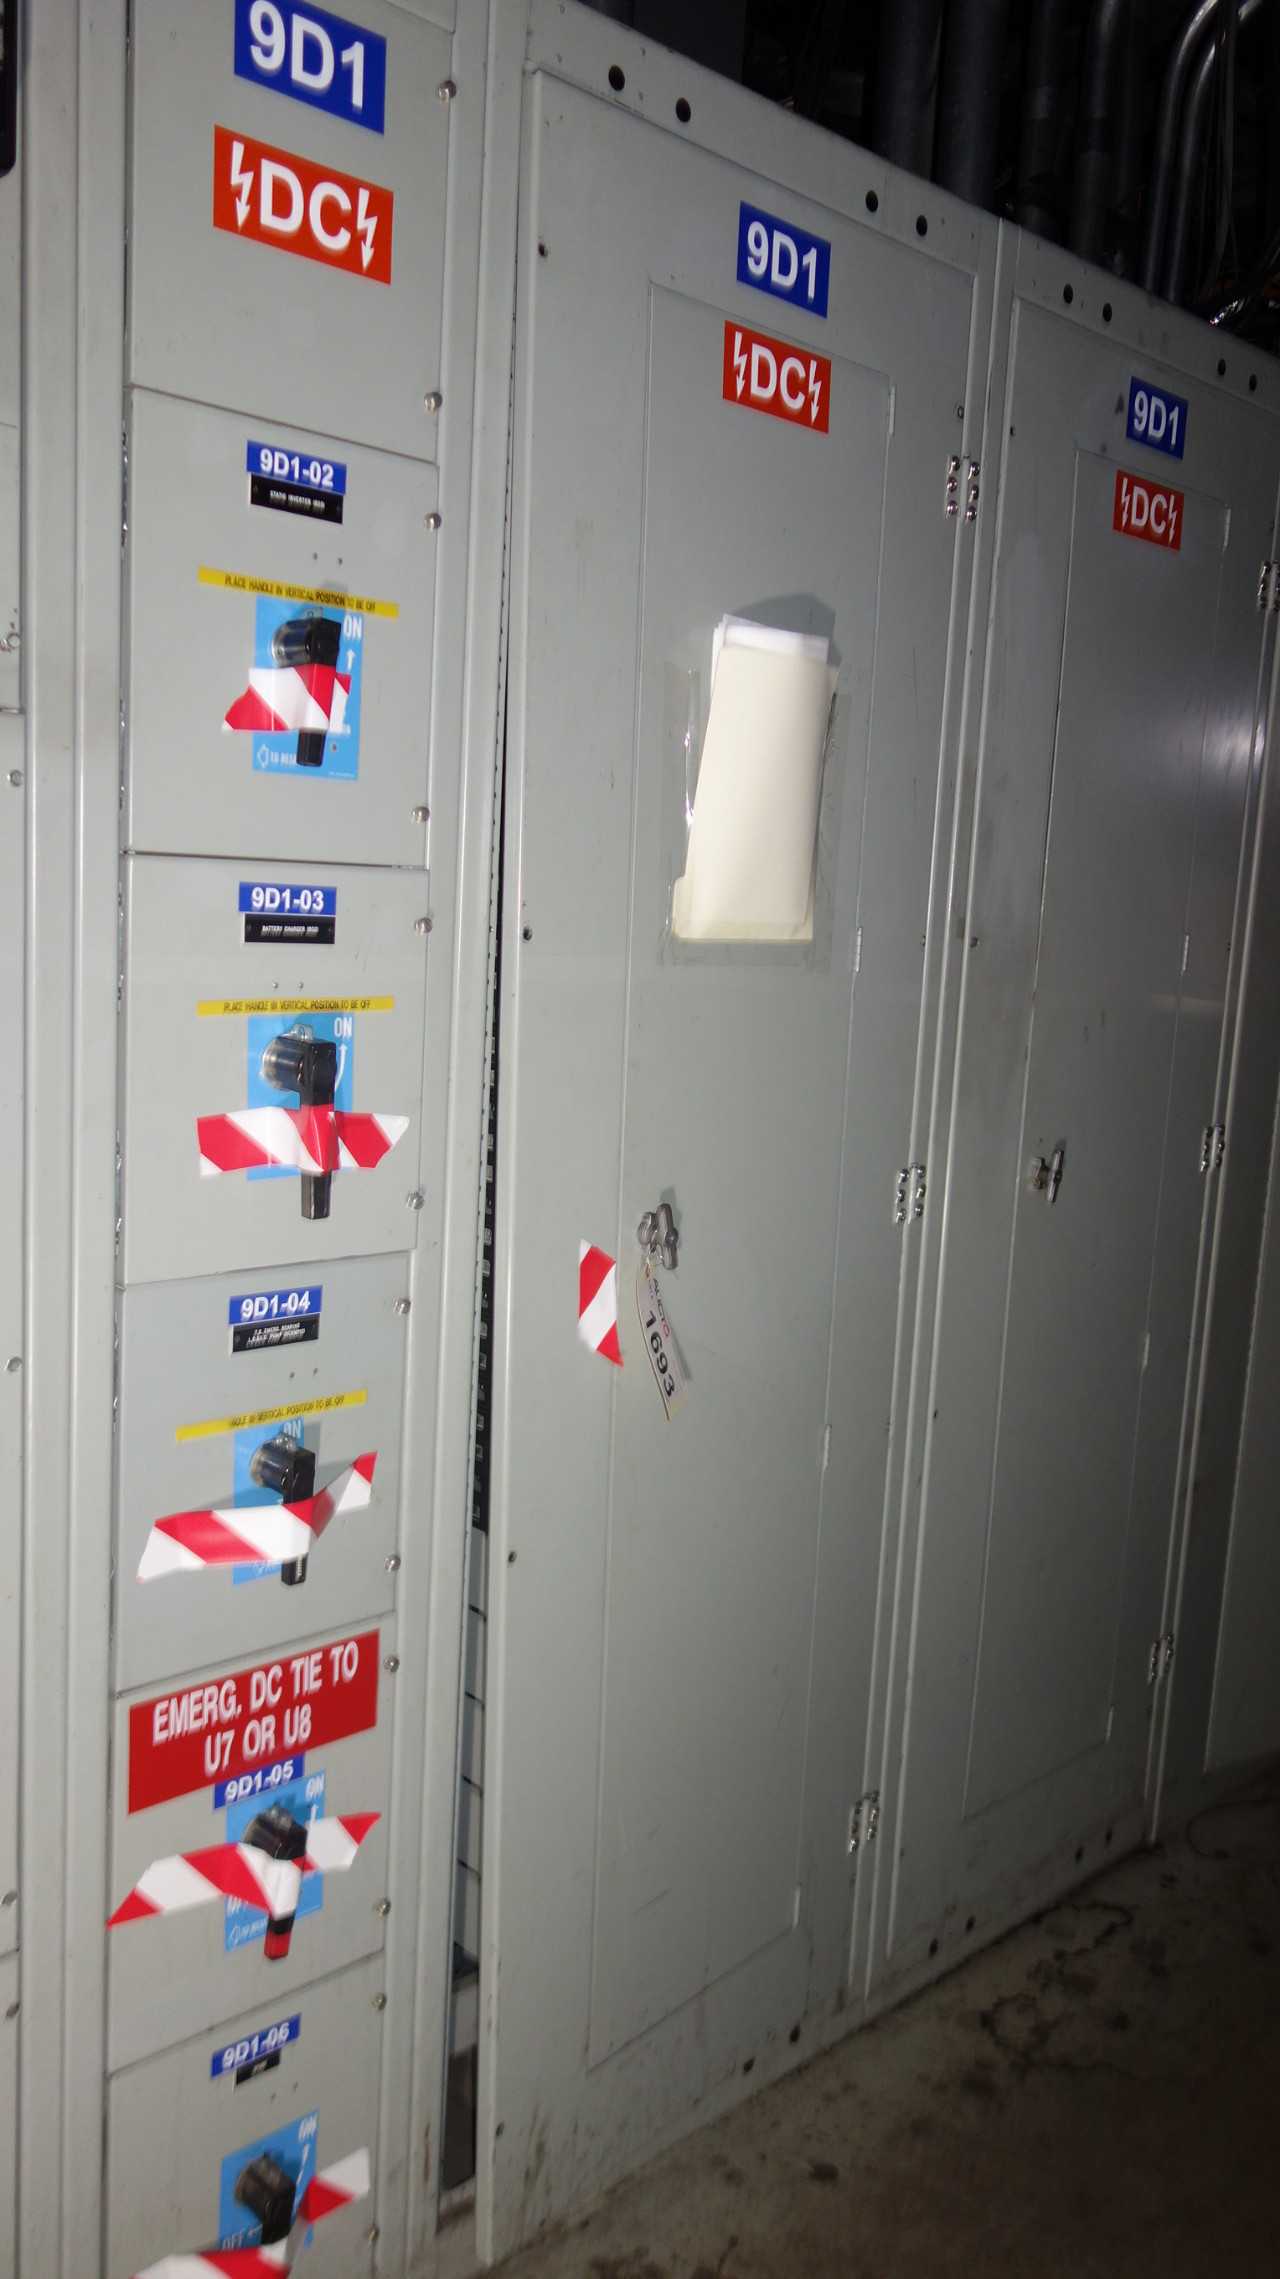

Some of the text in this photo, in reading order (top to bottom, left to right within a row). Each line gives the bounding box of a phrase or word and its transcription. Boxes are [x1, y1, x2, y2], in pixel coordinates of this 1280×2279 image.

[249, 0, 365, 110] 9D1
[260, 158, 352, 252] DC
[747, 221, 818, 302] 9D1
[750, 343, 807, 411] DC
[1134, 390, 1180, 447] 9D1
[260, 448, 334, 489] 9D1-02
[1131, 486, 1168, 535] DC
[315, 590, 346, 607] POSITION
[343, 614, 362, 640] ON
[251, 886, 324, 912] 9D1-03
[279, 999, 309, 1010] VERTICAL
[310, 999, 339, 1010] POSITION
[350, 999, 359, 1009] BE
[334, 1017, 352, 1037] ON
[241, 1290, 310, 1319] 9D1-04
[645, 1310, 676, 1398] 1693
[153, 1640, 359, 1745] EMERG. DC TIE TO
[204, 1703, 312, 1777] U7 OR U8
[224, 1759, 295, 1802] 9D1-05
[306, 1773, 324, 1801] ON
[222, 2021, 290, 2069] 9D1-06
